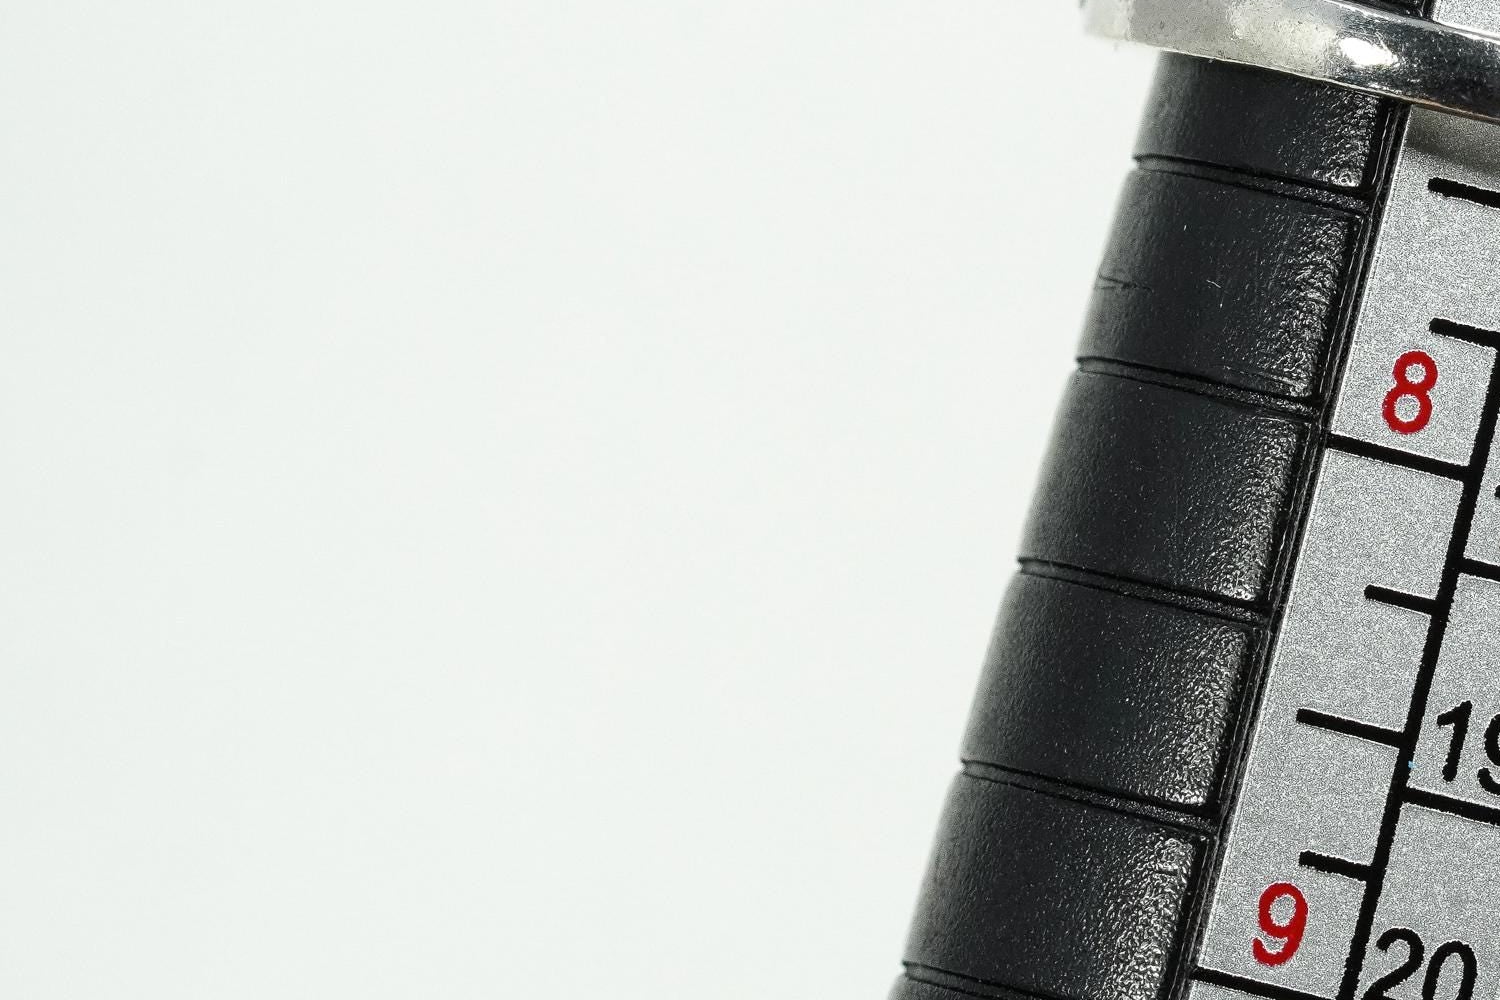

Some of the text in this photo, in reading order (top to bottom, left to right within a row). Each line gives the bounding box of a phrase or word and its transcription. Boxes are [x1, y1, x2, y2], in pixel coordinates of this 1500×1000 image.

[1381, 351, 1439, 435] 8
[1251, 882, 1309, 967] 9
[1362, 927, 1479, 1000] 20
